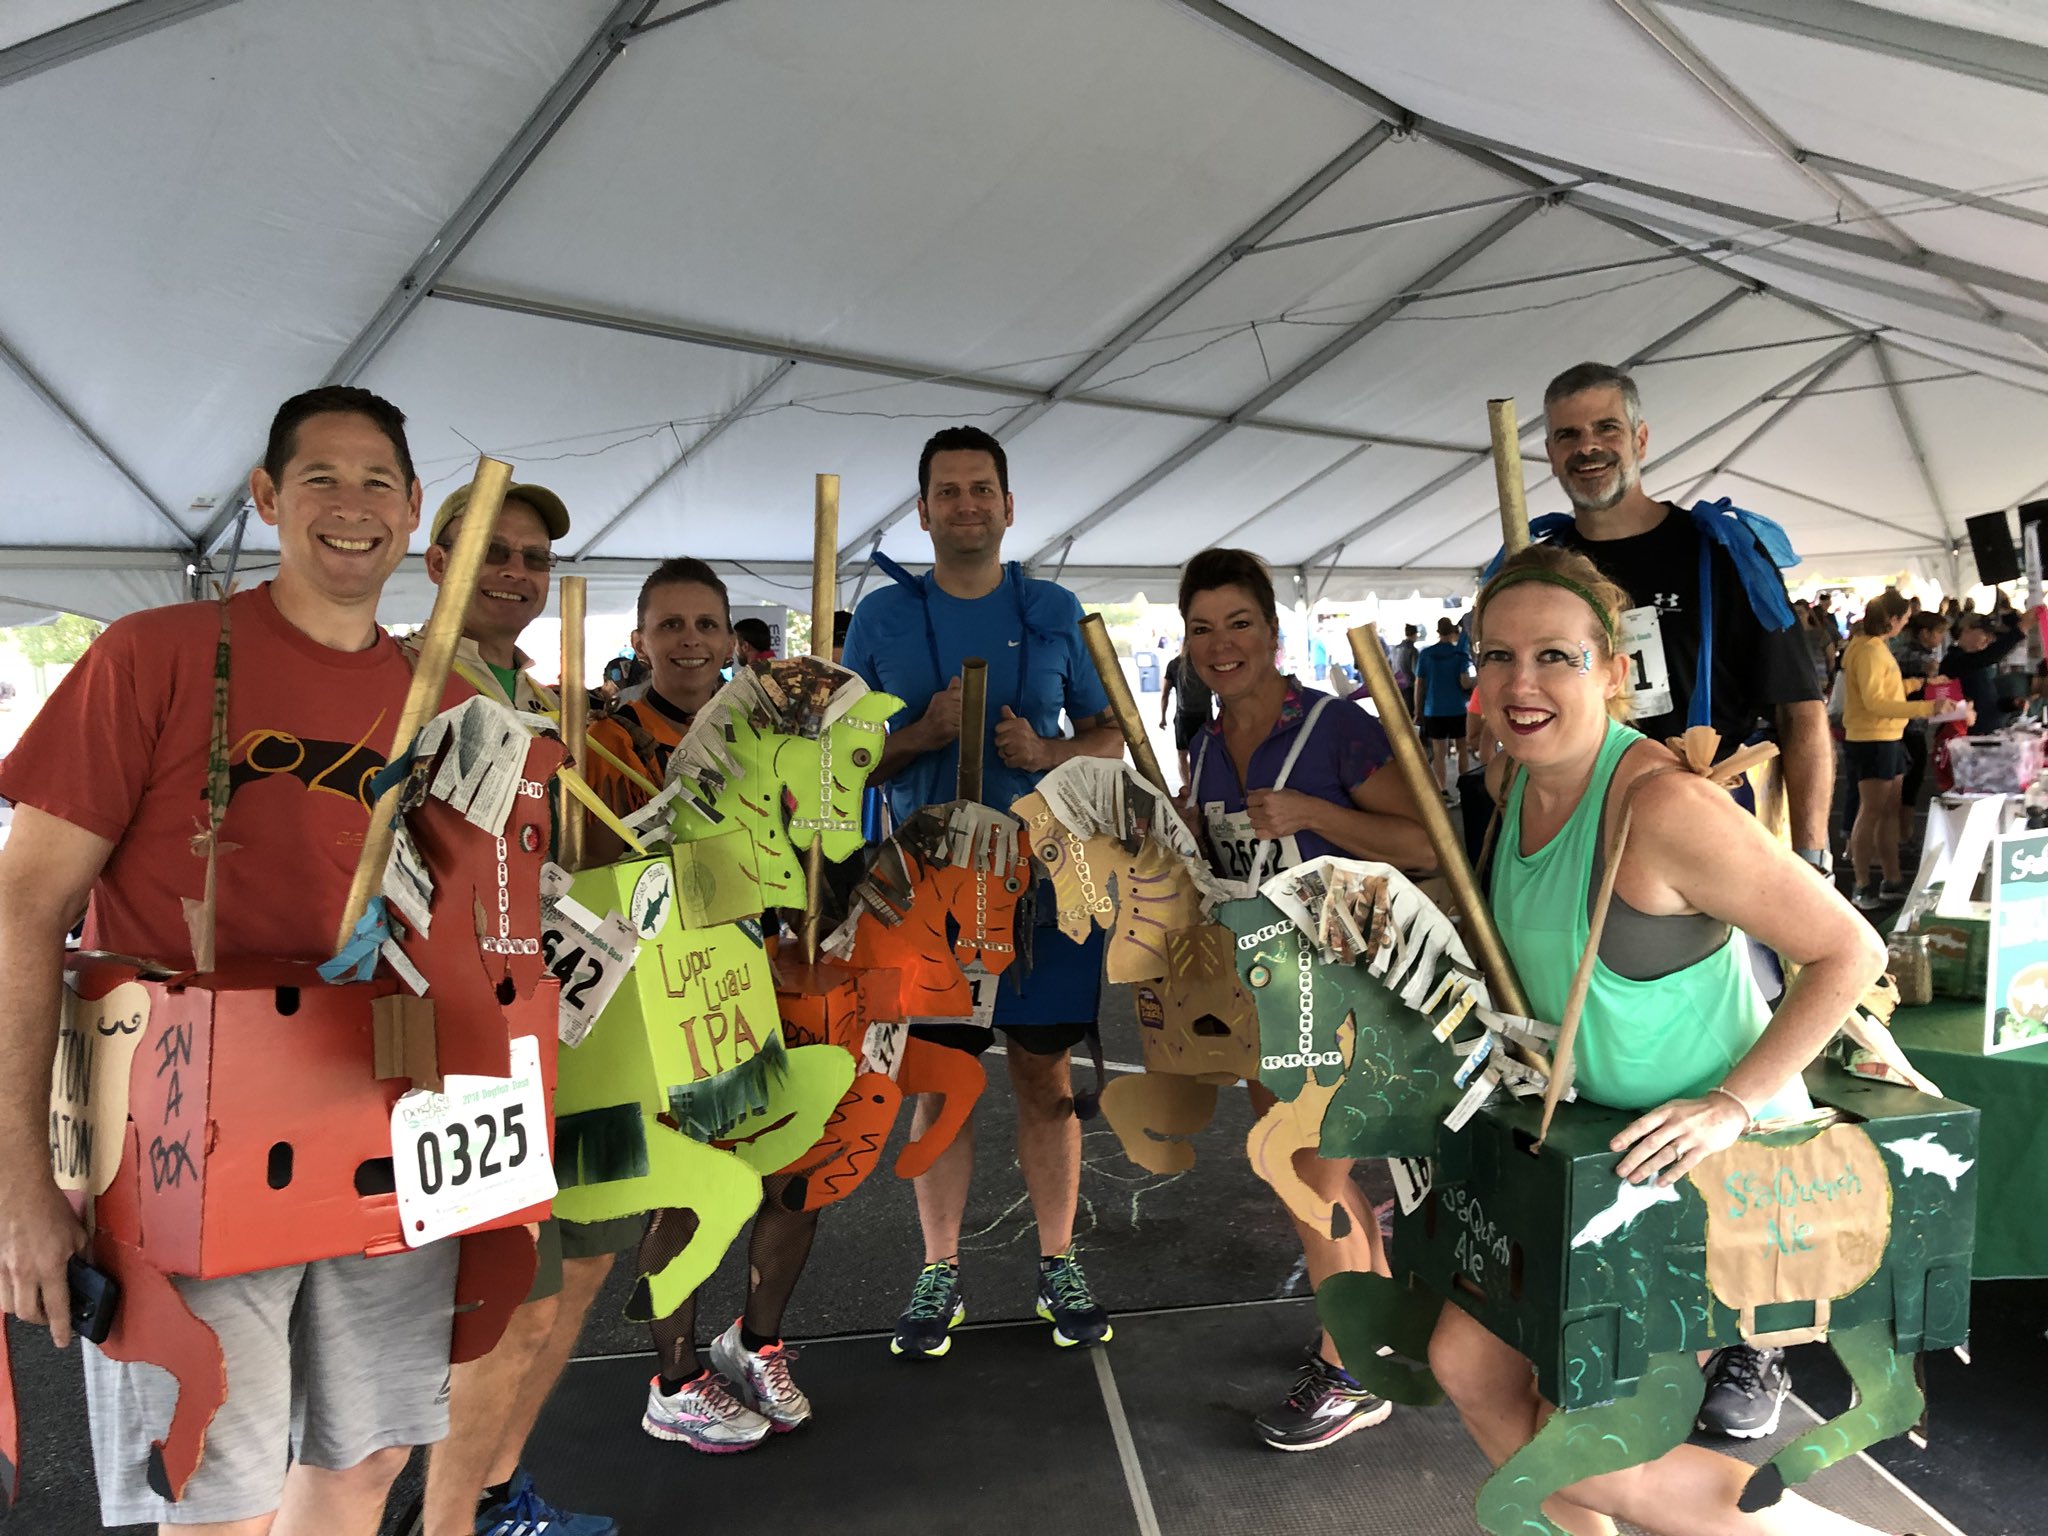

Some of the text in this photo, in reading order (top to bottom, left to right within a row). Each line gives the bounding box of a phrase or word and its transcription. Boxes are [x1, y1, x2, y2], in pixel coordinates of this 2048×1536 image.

[702, 963, 752, 1011] Luau
[156, 1023, 193, 1078] IN
[678, 1004, 761, 1081] IPA
[164, 1070, 184, 1125] A
[149, 1129, 199, 1194] BOX
[416, 1102, 528, 1195] 0325
[1454, 1230, 1484, 1283] Ale
[1762, 1214, 1816, 1260] Ale
